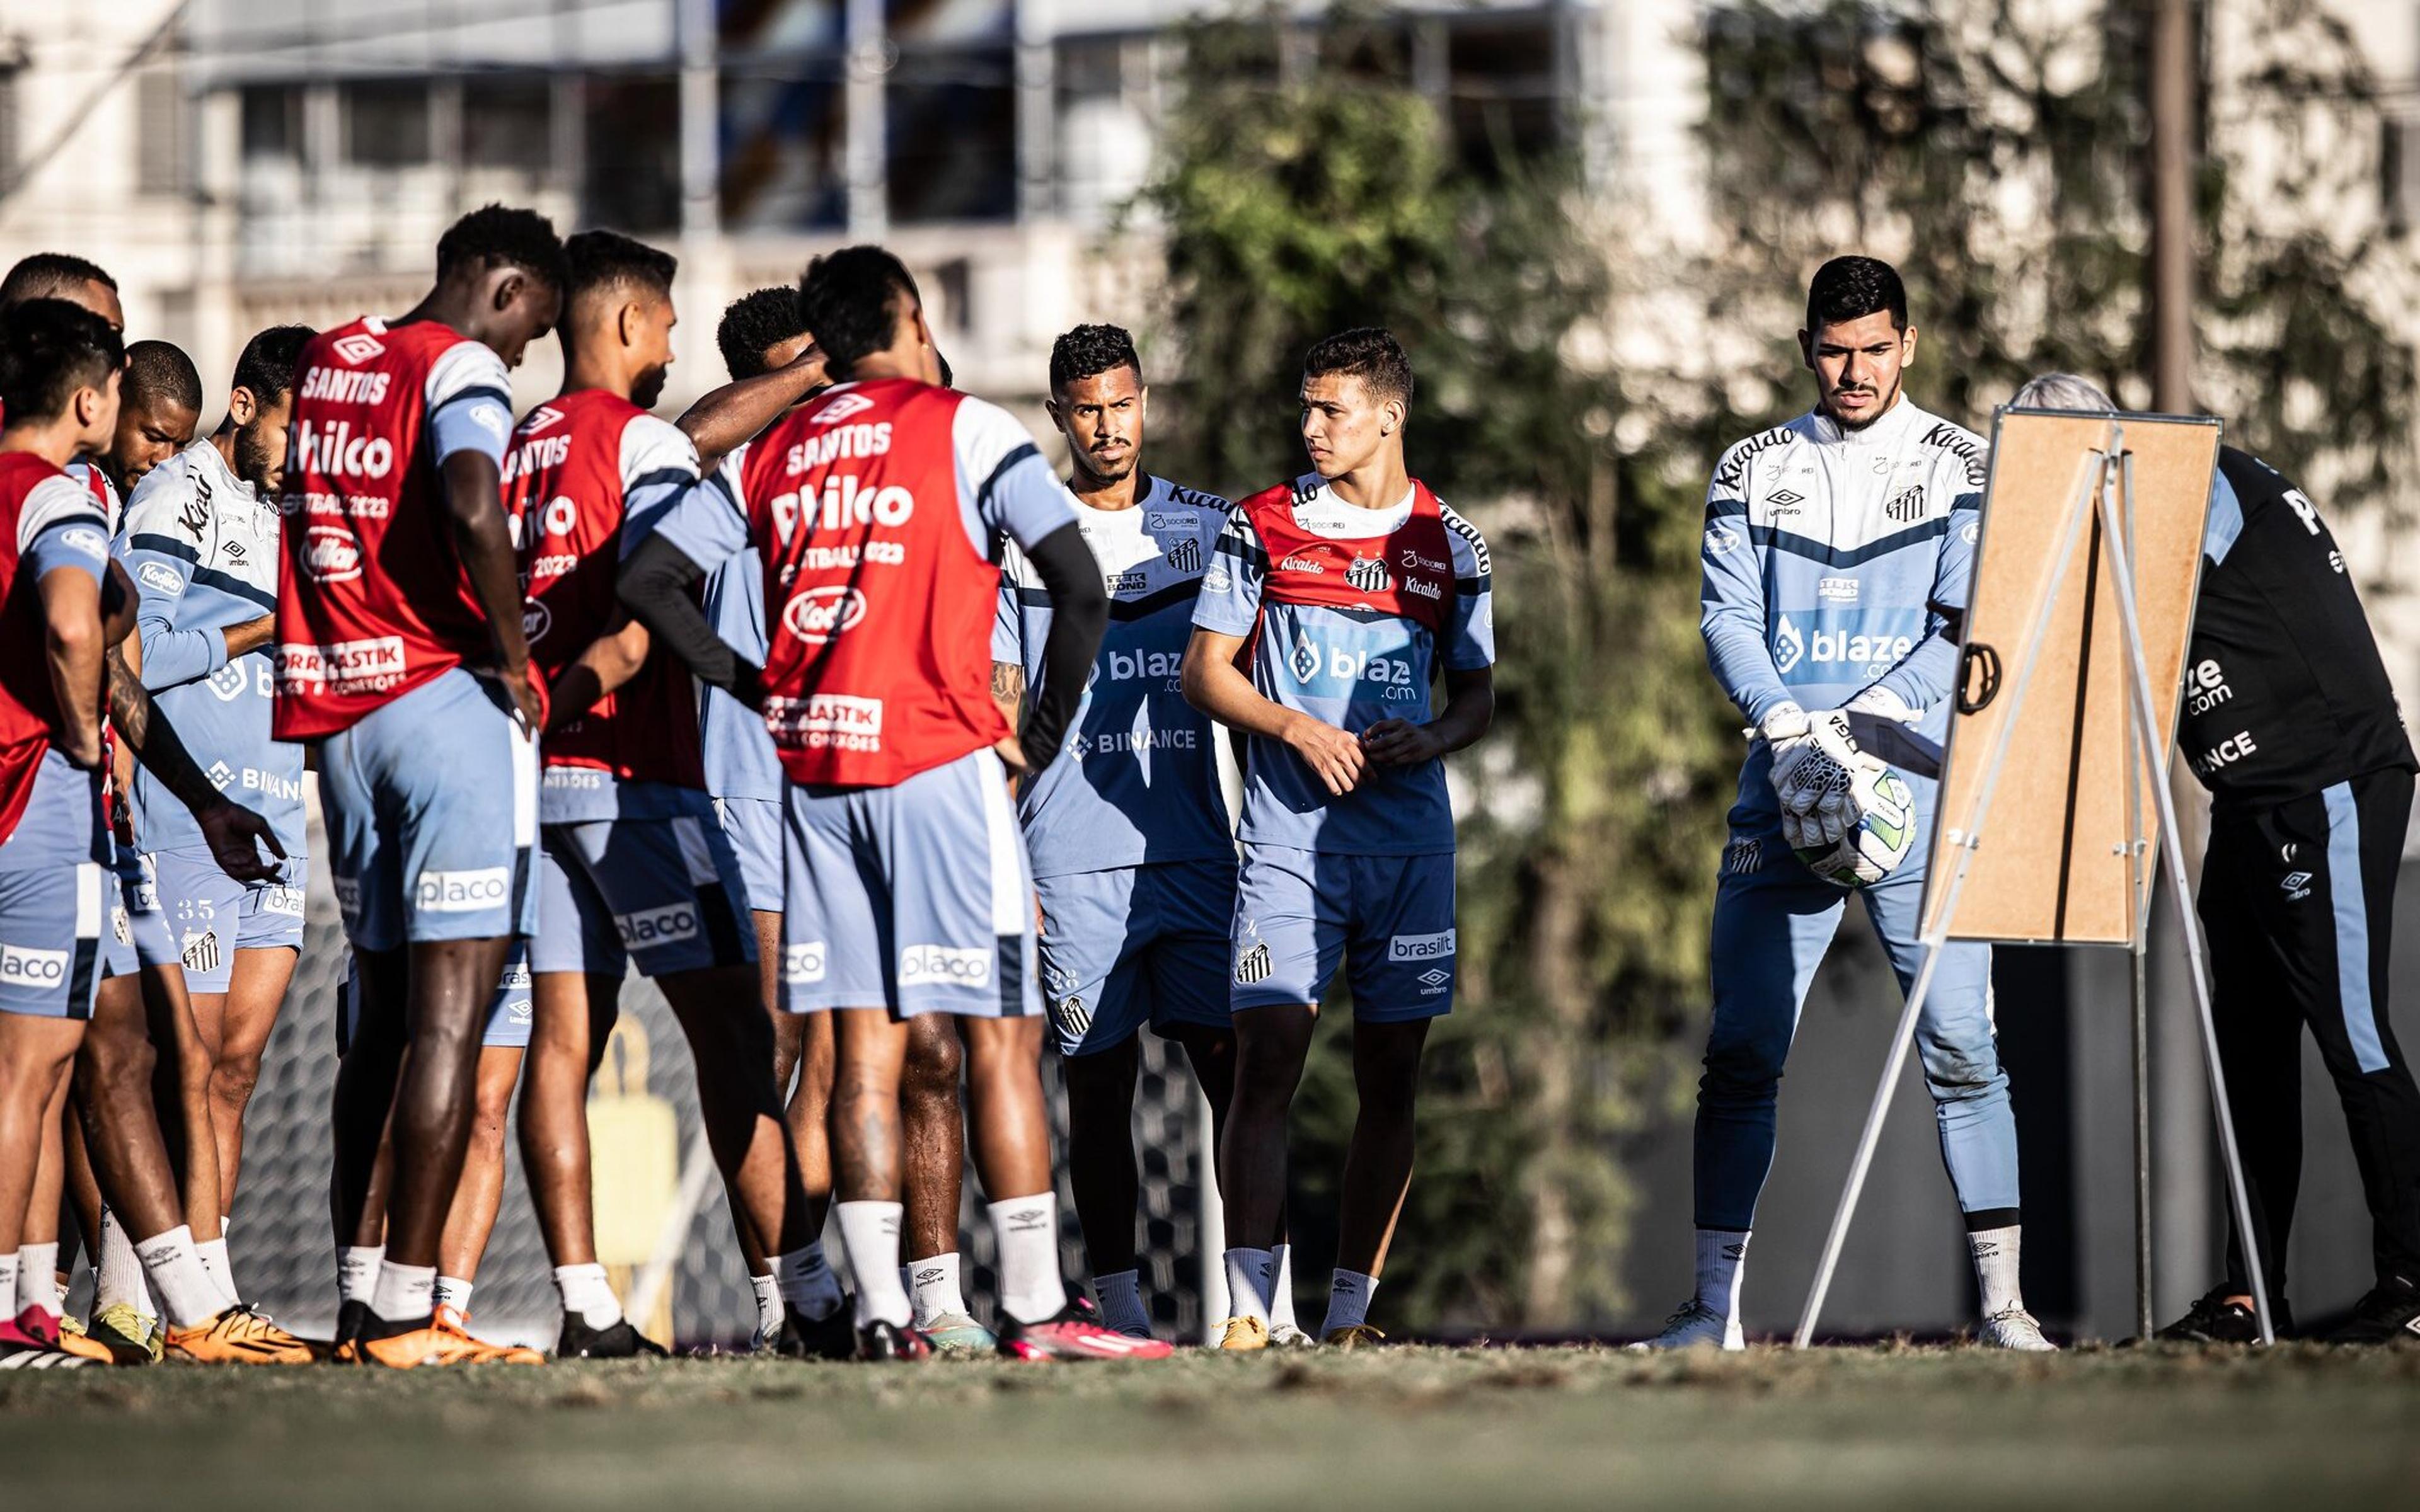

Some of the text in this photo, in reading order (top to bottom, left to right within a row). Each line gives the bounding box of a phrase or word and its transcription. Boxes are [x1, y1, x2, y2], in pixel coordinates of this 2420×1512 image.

[301, 365, 391, 405] SANTOS
[786, 423, 892, 477] SANTOS
[1715, 427, 1796, 492] Kicaldo
[1770, 508, 1801, 517] umbro
[1439, 502, 1490, 573] icaldo
[1107, 581, 1146, 591] BOND
[1405, 575, 1441, 600] Kicaldo
[1811, 630, 1912, 662] blaze
[1098, 730, 1196, 753] BINANCE
[243, 768, 302, 801] BINAN
[420, 876, 505, 907] placo
[903, 946, 988, 978] placo
[1420, 986, 1448, 995] umbro
